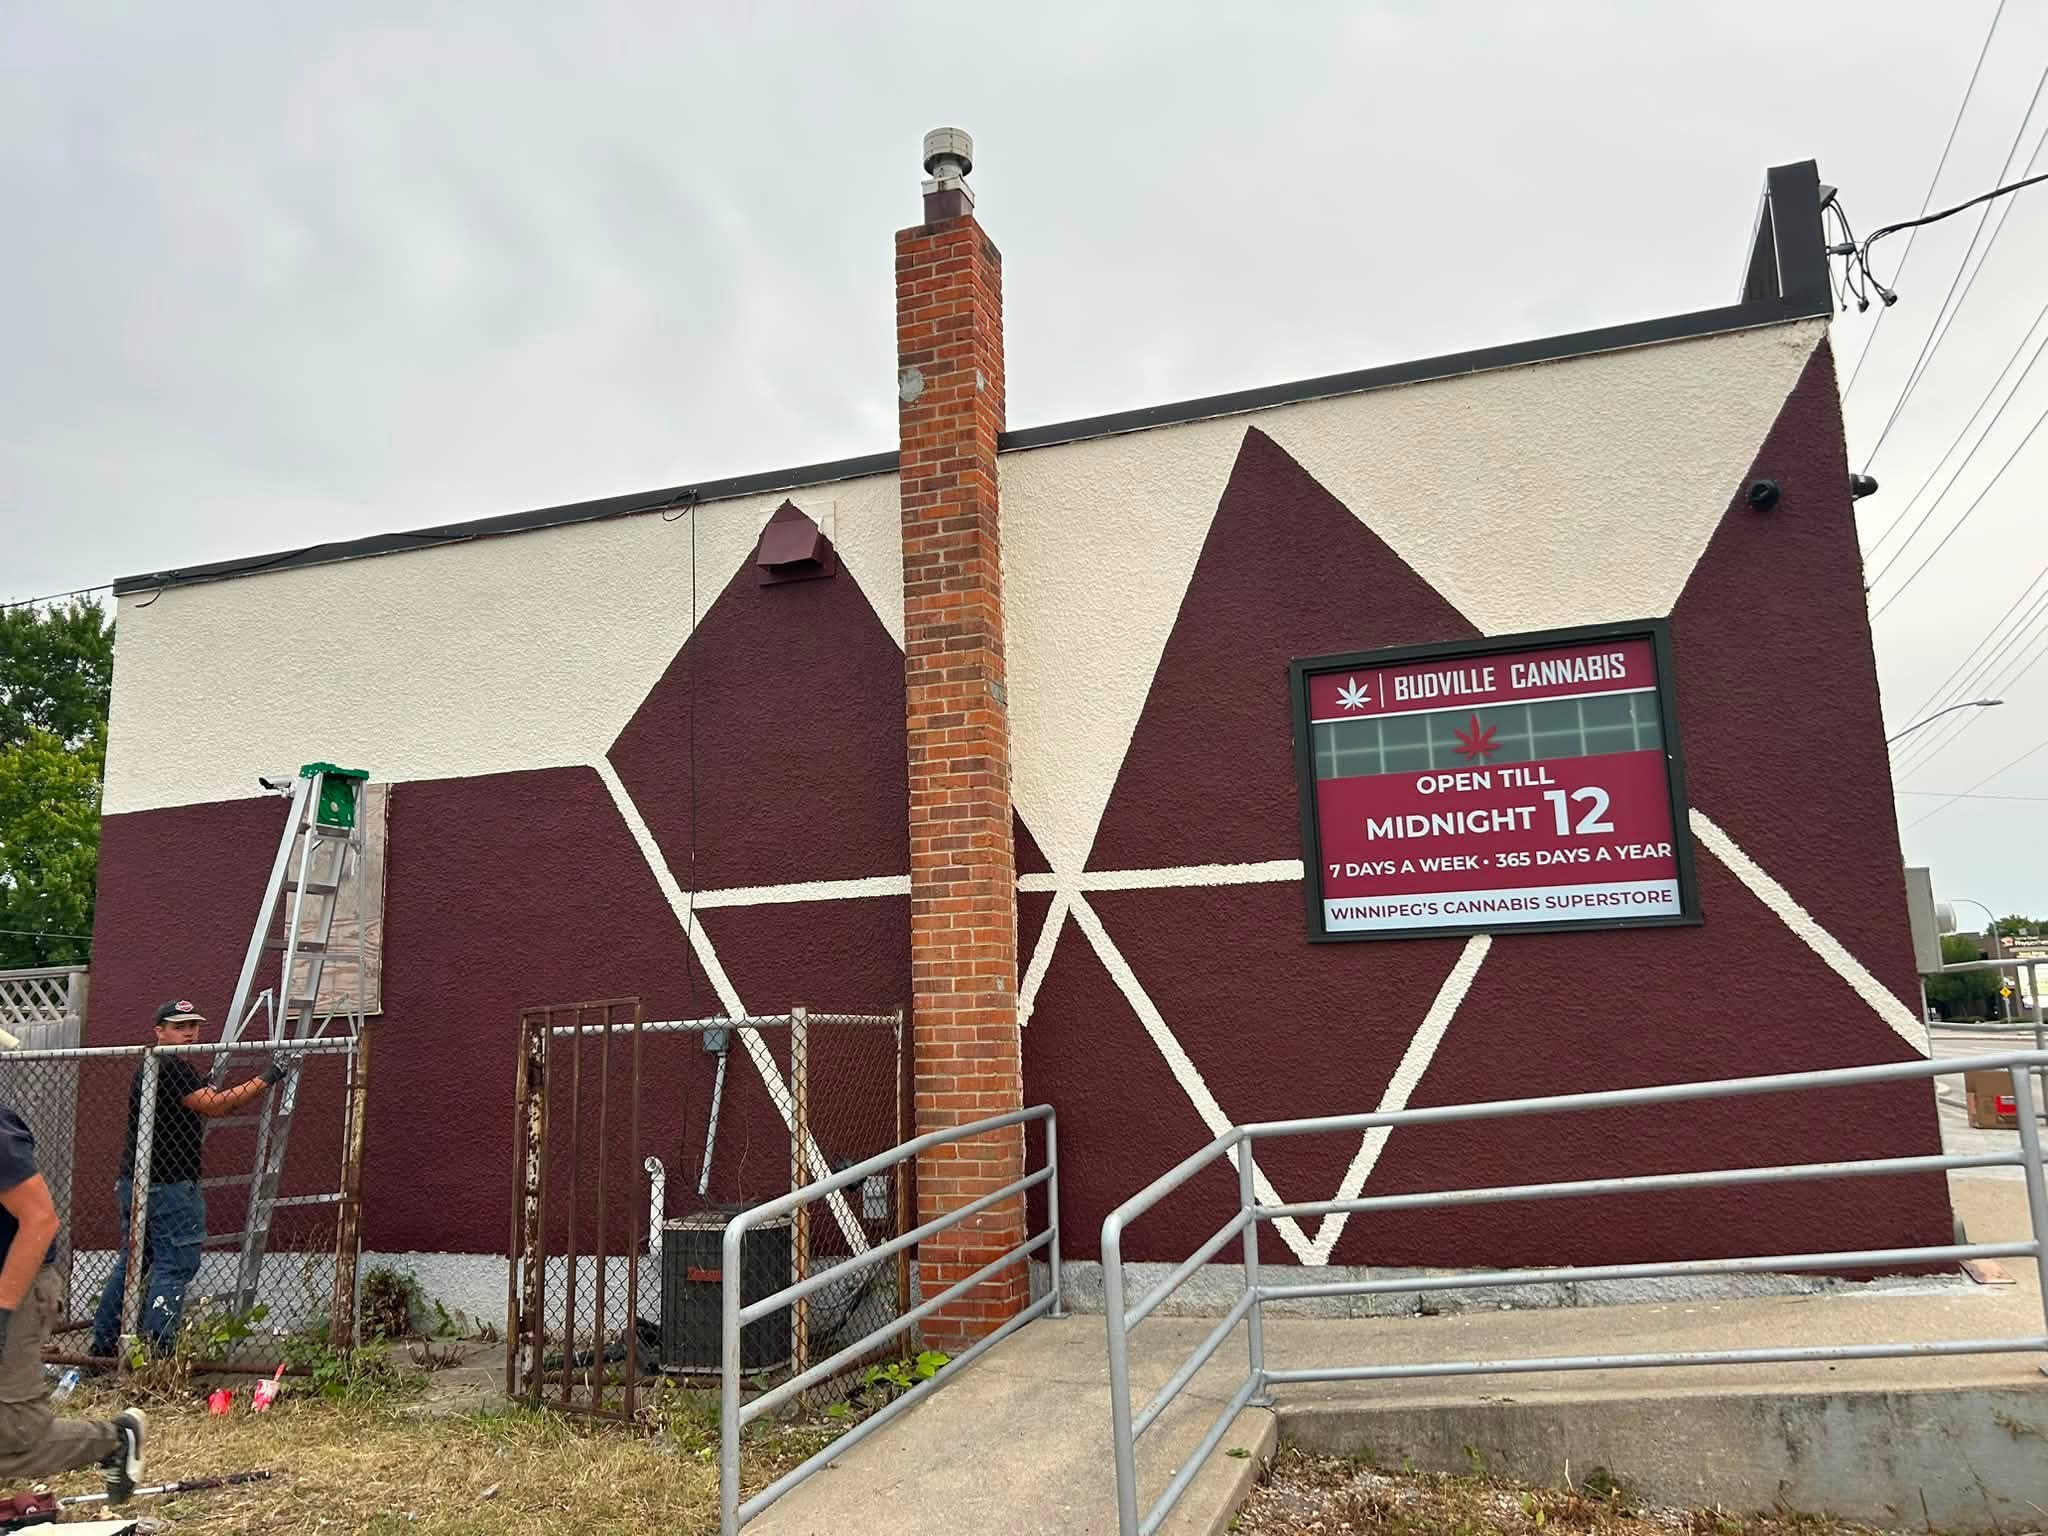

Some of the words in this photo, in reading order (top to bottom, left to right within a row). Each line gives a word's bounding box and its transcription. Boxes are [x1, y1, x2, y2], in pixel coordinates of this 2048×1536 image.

[1394, 667, 1496, 700] BUDVILLE
[1510, 653, 1626, 688] CANNABIS
[1416, 772, 1491, 794] OPEN
[1498, 766, 1555, 788] TILL
[1366, 806, 1536, 840] MIDNIGHT
[1544, 786, 1614, 836] 12
[1330, 864, 1341, 879] 7
[1346, 860, 1396, 878] DAYS
[1400, 860, 1416, 874] A
[1419, 855, 1480, 873] WEEK
[1495, 852, 1531, 868] 365
[1536, 848, 1592, 866] DAYS
[1595, 846, 1612, 862] A
[1614, 843, 1673, 860] YEAR
[1330, 902, 1439, 920] WINNIPEG'S
[1443, 896, 1541, 914] CANNABIS
[1546, 889, 1673, 909] SUPERSTORE
